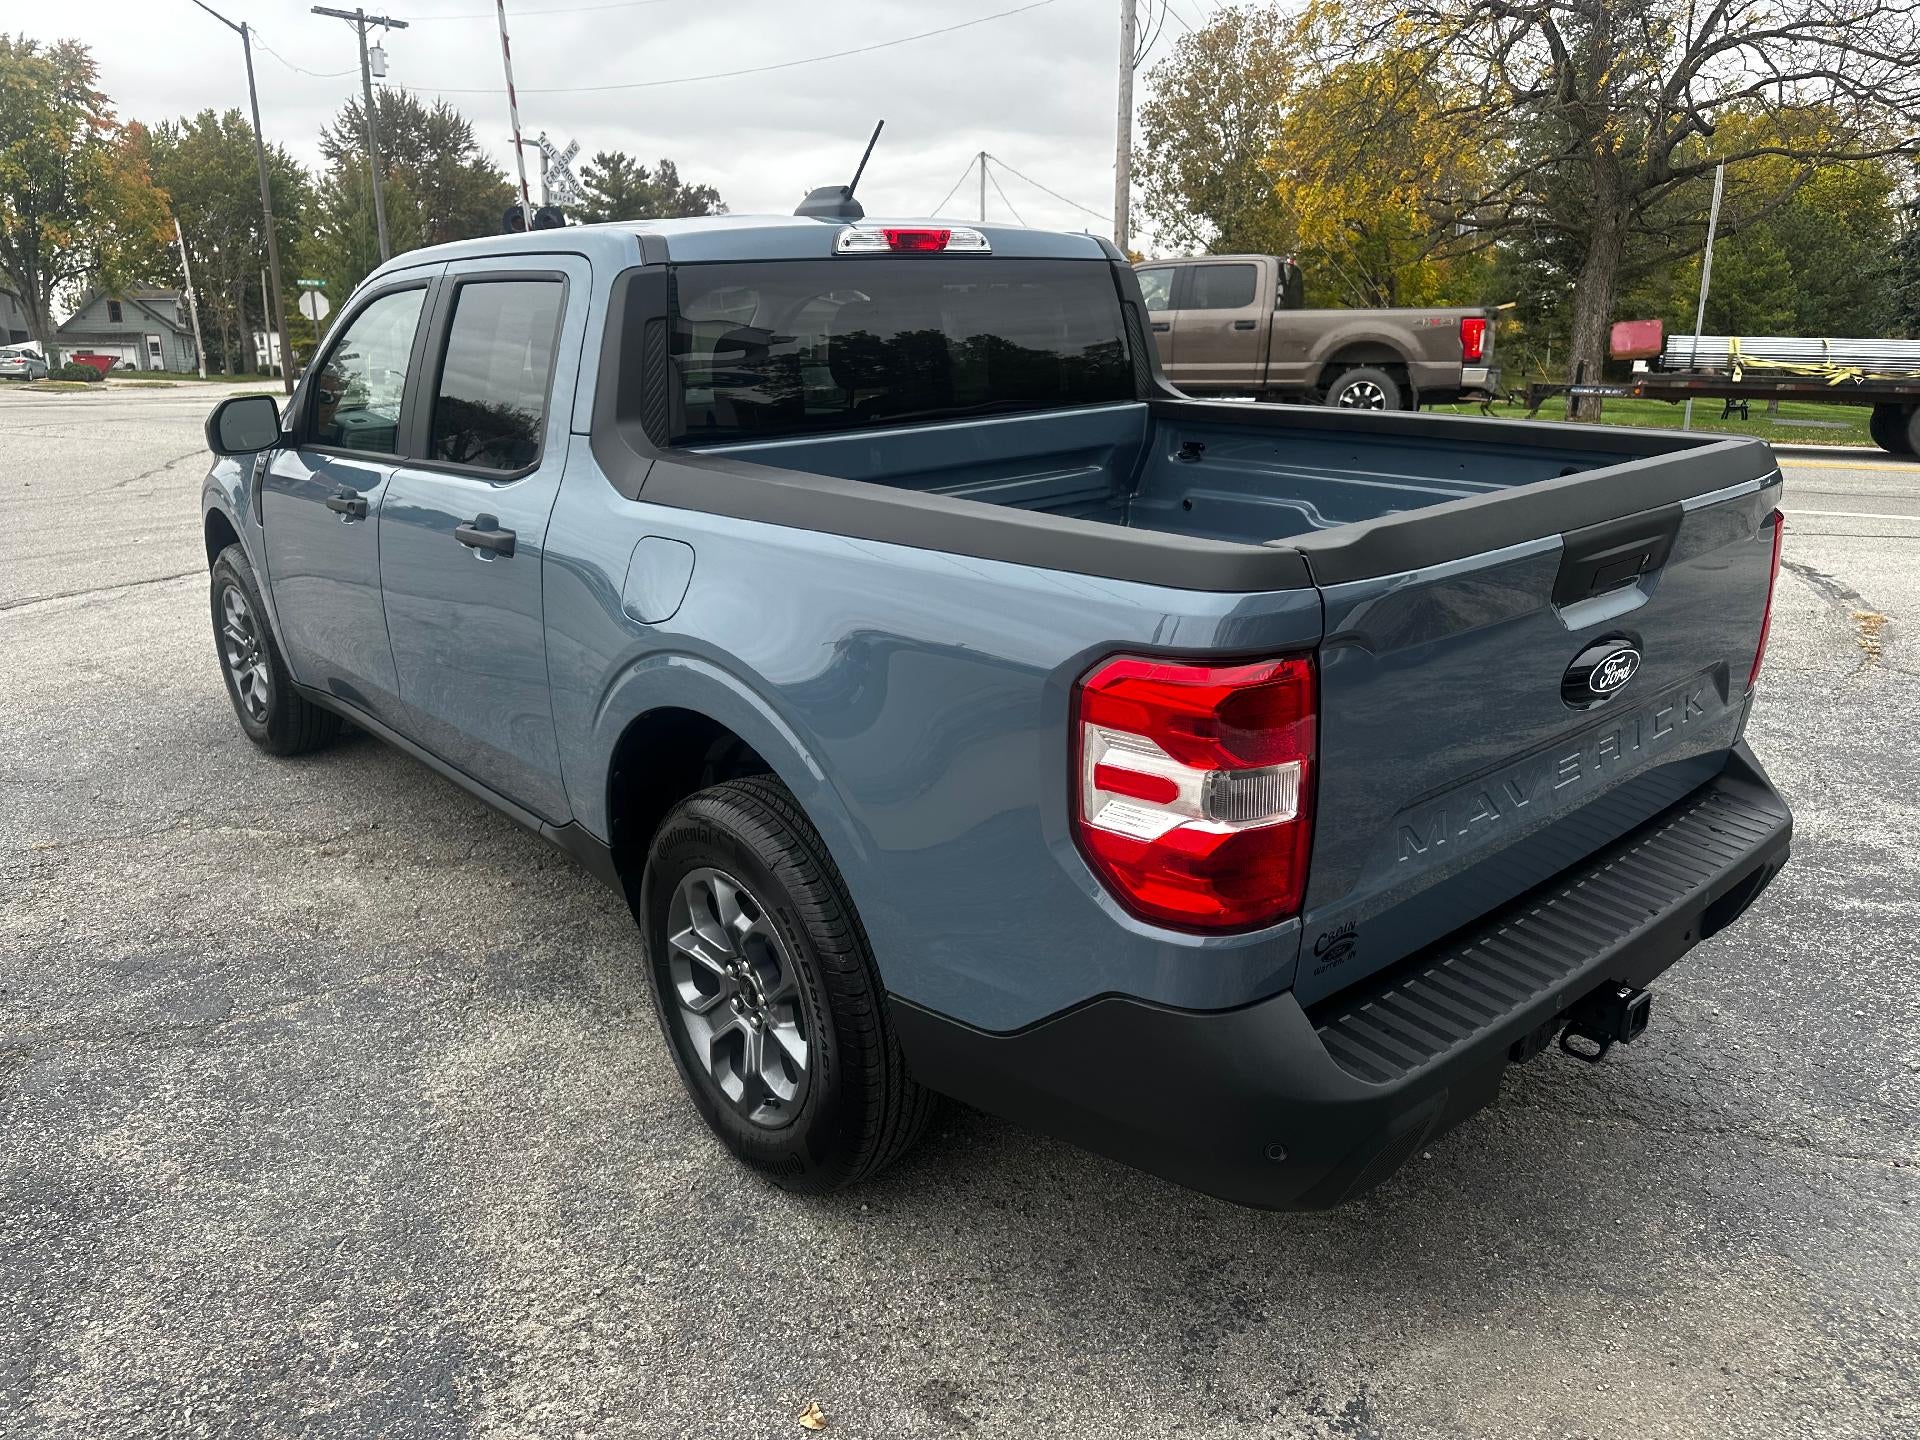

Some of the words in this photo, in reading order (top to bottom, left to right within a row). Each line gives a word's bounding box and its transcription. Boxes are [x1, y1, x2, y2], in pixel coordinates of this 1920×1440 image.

[539, 135, 557, 159] RAIL
[563, 168, 580, 191] ROAD
[546, 142, 578, 186] CROSSING
[560, 183, 565, 193] 2
[1600, 655, 1632, 689] Ford
[1398, 689, 1704, 862] MAVERICK
